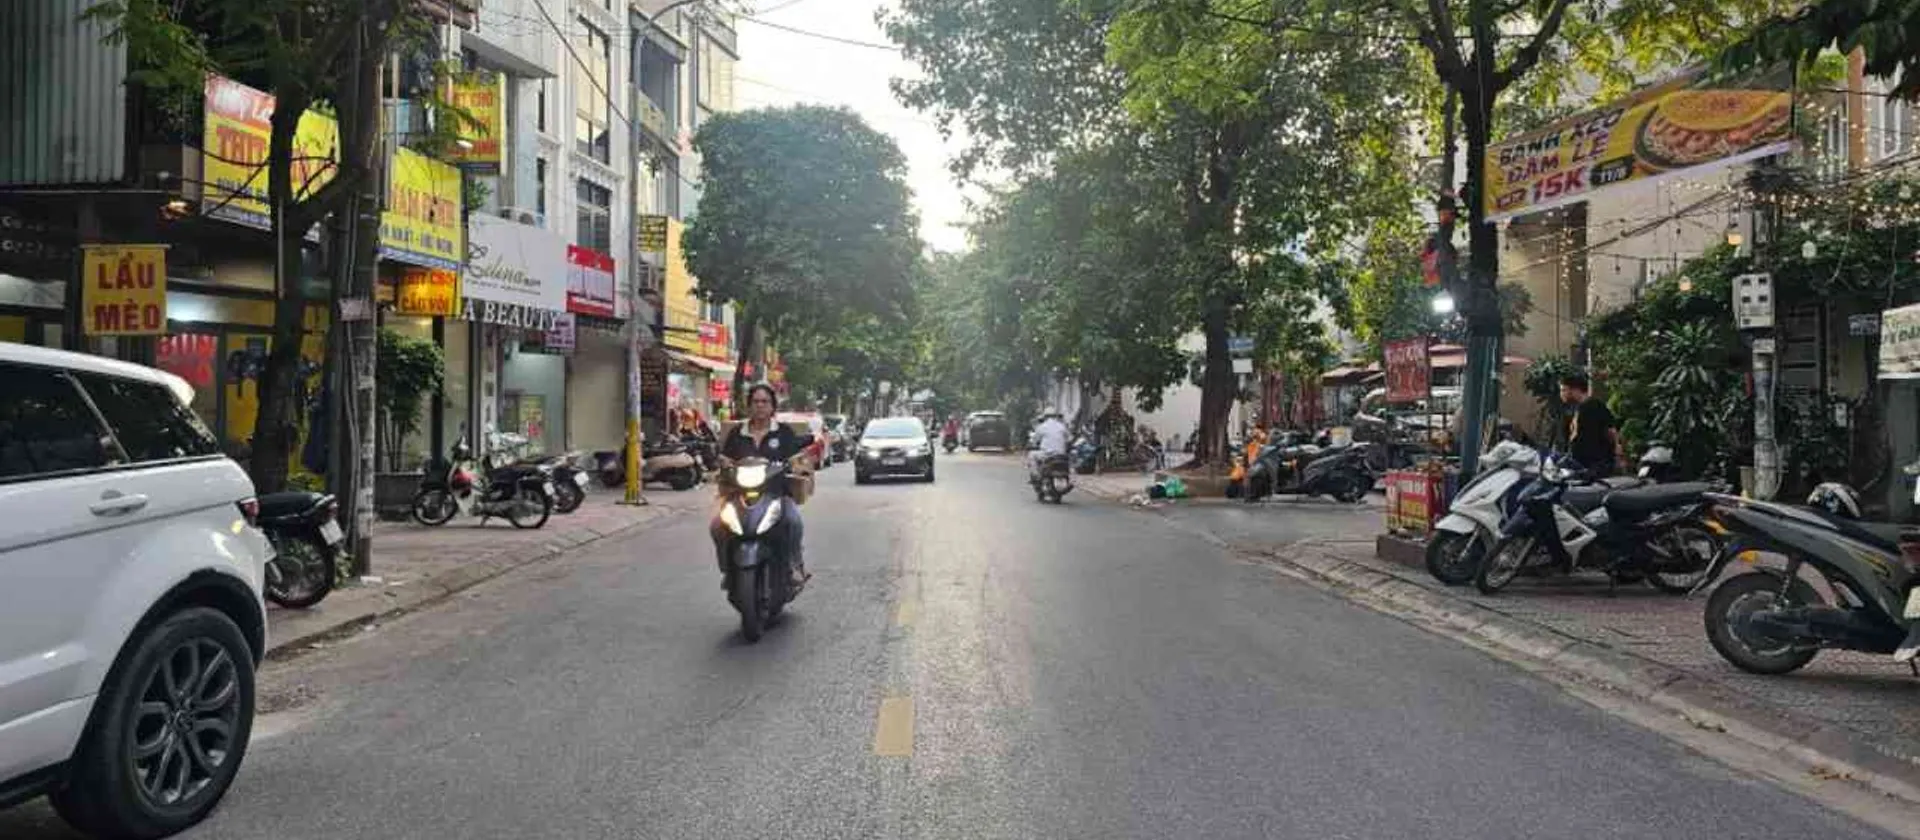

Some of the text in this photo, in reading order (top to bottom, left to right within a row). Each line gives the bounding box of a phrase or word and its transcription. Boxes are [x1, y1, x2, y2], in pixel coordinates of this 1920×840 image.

[1532, 165, 1586, 204] 15K
[97, 252, 156, 289] LẨU
[93, 299, 161, 331] MÈO
[484, 301, 561, 331] BEAUTY
